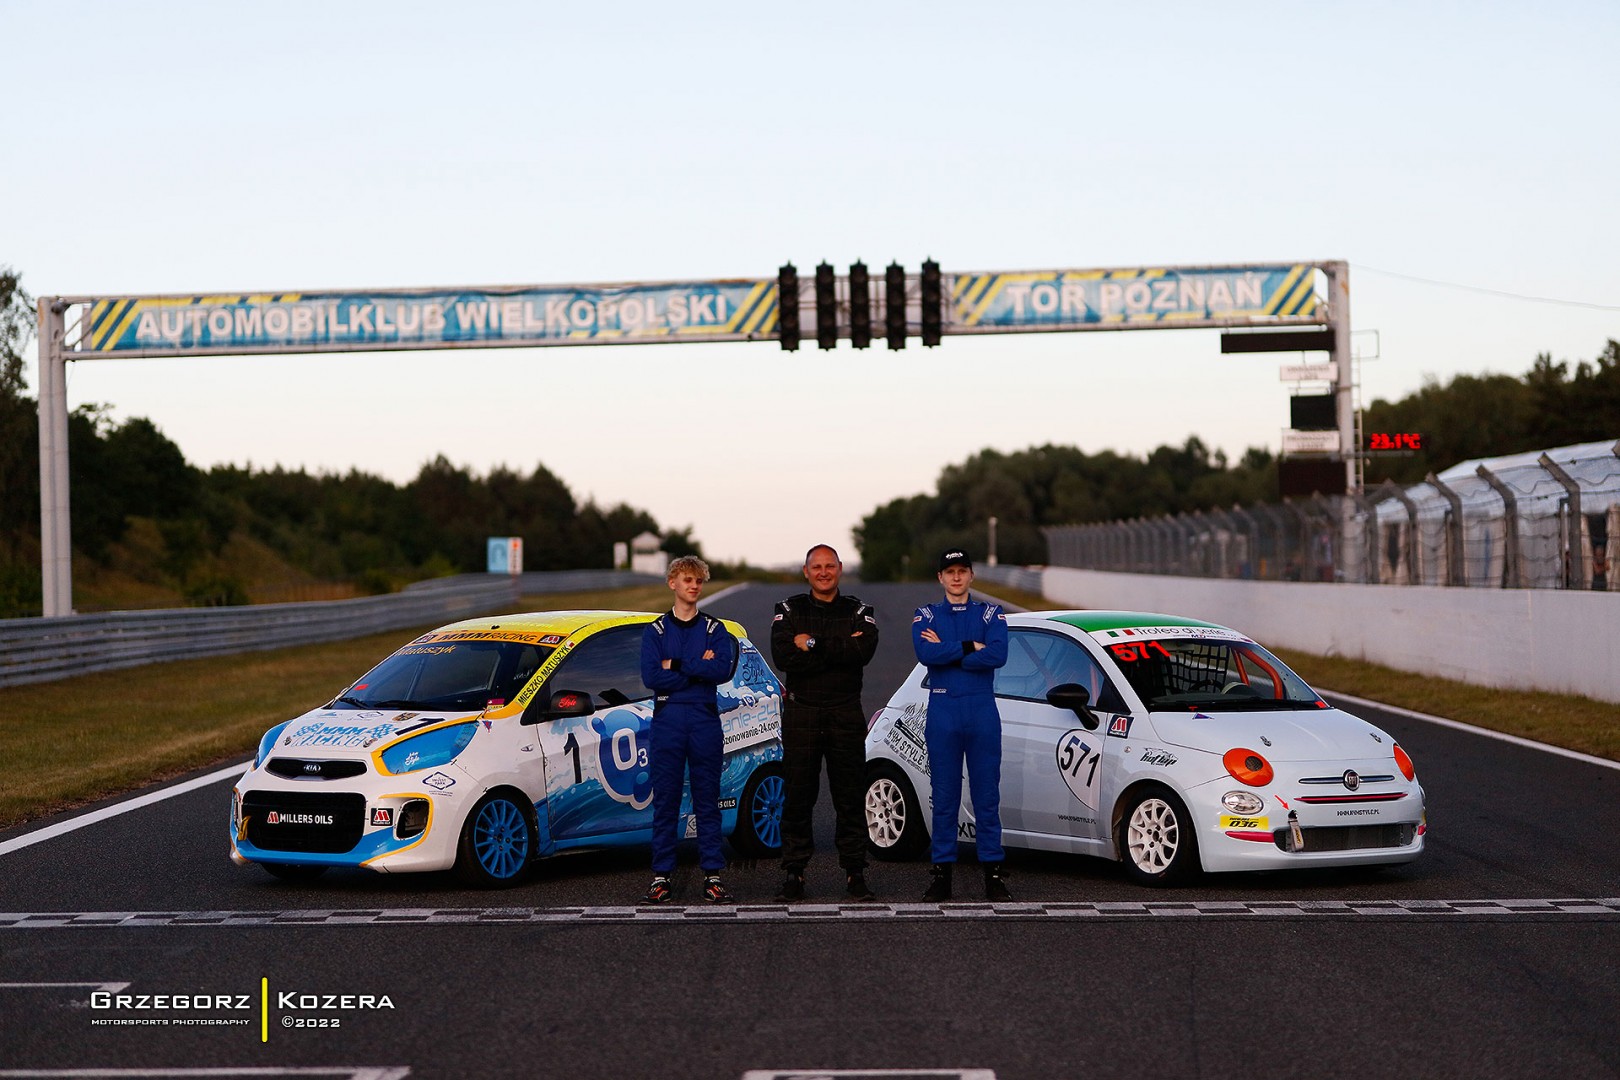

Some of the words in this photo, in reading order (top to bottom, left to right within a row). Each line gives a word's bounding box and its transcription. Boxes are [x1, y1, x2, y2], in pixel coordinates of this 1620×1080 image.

[1005, 283, 1089, 315] TOR
[1101, 271, 1262, 312] POZNAŃ
[135, 302, 446, 340] AUTOMOBILKLUB
[456, 293, 727, 331] WIELKOPOLSKI
[1134, 627, 1180, 636] Trofeo
[1182, 627, 1195, 635] di
[1110, 640, 1171, 662] 571
[517, 675, 544, 706] MIESZKO
[541, 644, 571, 678] MATUSZYK
[395, 717, 446, 736] 1
[563, 733, 582, 783] 1
[900, 740, 925, 766] STYLE
[1060, 735, 1101, 788] 571
[305, 764, 318, 772] KIA
[280, 813, 313, 824] MILLERS
[315, 814, 334, 825] OILS
